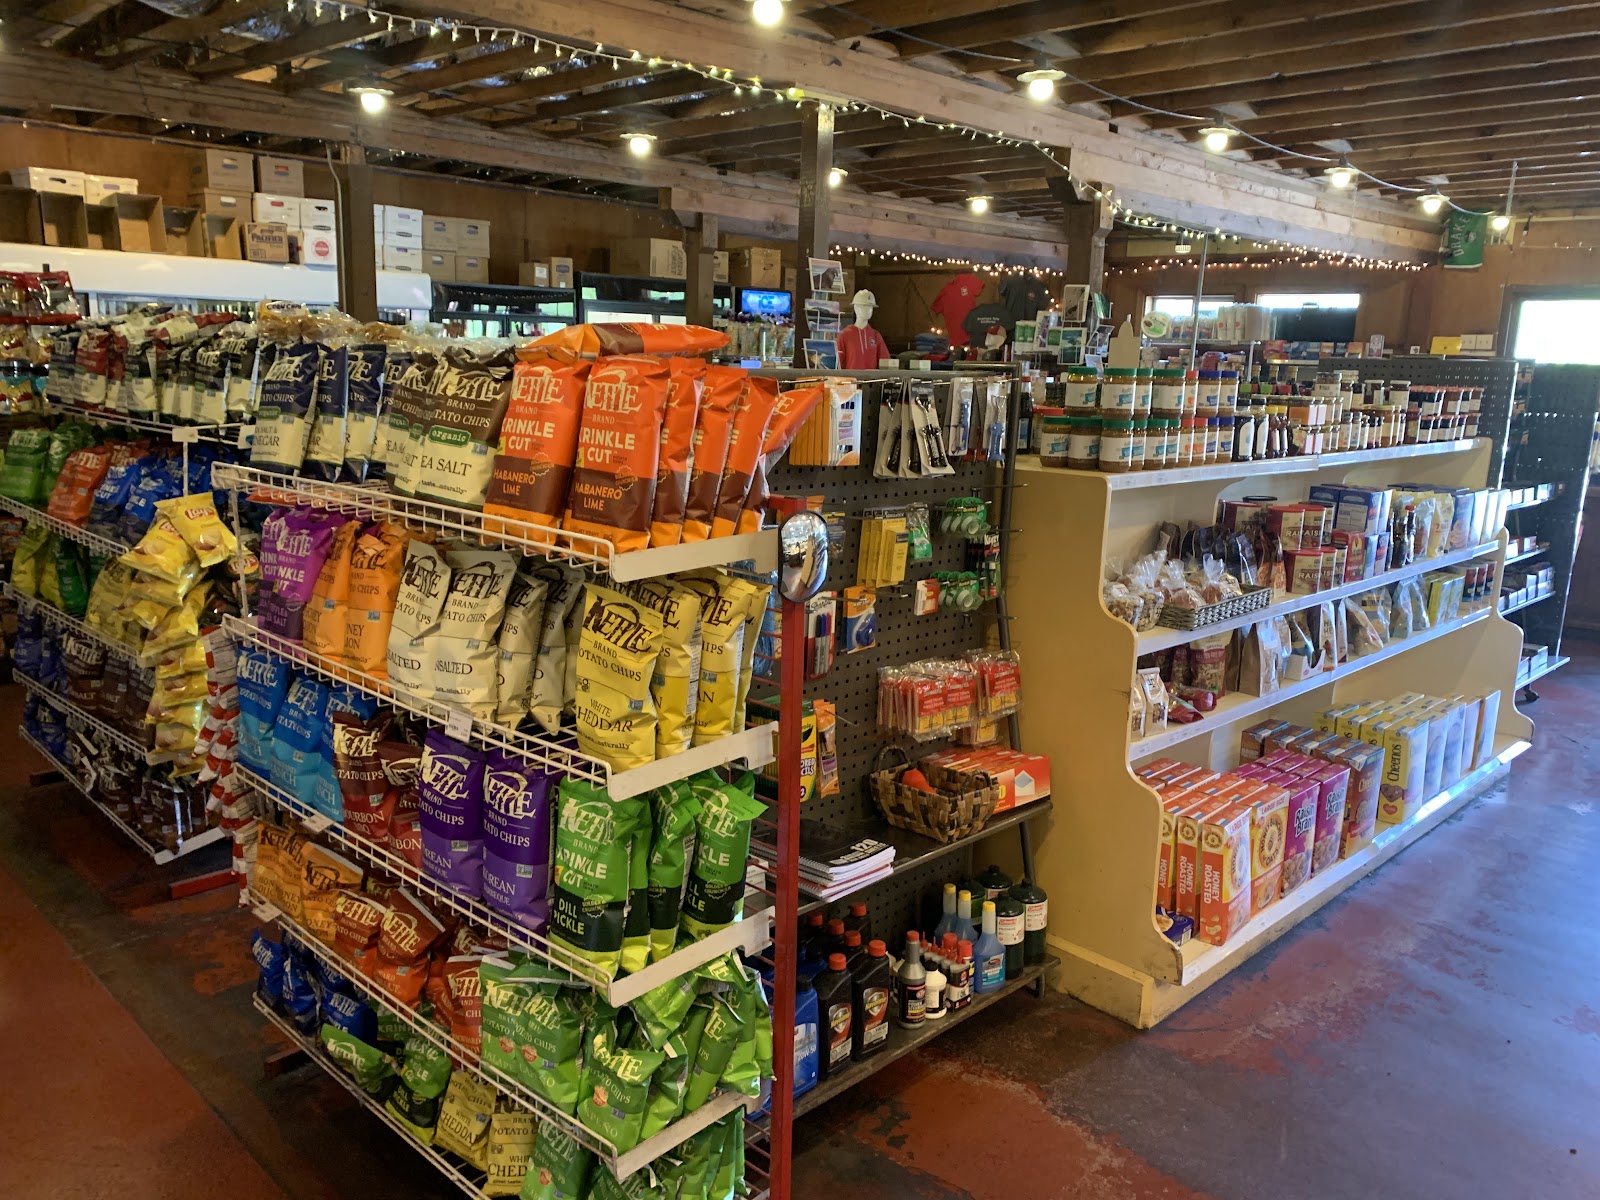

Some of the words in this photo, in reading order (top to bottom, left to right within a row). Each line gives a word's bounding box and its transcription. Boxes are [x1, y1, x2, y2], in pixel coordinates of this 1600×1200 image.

[1451, 215, 1471, 257] DRAKE
[446, 398, 476, 412] BRAND
[515, 405, 538, 416] BRAND
[434, 408, 462, 424] TATO
[462, 415, 492, 429] CHIPS
[591, 414, 615, 426] BRAND
[254, 436, 280, 447] NEGAR
[431, 430, 467, 443] organic
[508, 436, 532, 452] CUT
[586, 446, 613, 465] CUT
[420, 454, 434, 470] EA
[435, 458, 472, 477] SALT
[493, 468, 537, 486] HABANERO
[502, 484, 521, 497] LIME
[574, 481, 623, 501] HABANERO
[583, 497, 605, 512] LIME
[260, 551, 277, 565] RINK
[277, 565, 306, 583] NKLE
[401, 553, 441, 600] KETTLE
[1298, 572, 1319, 580] RAIS
[357, 585, 380, 596] CHIPS
[395, 601, 415, 617] TATO
[451, 598, 479, 610] BRAND
[443, 609, 466, 623] TATO
[466, 613, 487, 624] CHIPS
[582, 595, 653, 655] KETTLE
[346, 623, 365, 637] NEY
[504, 624, 519, 636] IPS
[592, 640, 618, 660] BRAND
[236, 650, 280, 688] KETTLE
[387, 653, 422, 671] SALTED
[434, 660, 474, 676] NSALTED
[610, 662, 643, 683] CHIPS
[590, 698, 613, 719] WHITE
[577, 704, 634, 734] HEDDAR
[1387, 743, 1402, 782] Cheerios
[338, 768, 359, 781] TATO
[419, 744, 470, 801] KETTLE
[422, 788, 442, 807] BRAND
[483, 764, 536, 820] KETTLE
[1326, 786, 1345, 808] Raisin
[418, 798, 434, 816] TATO
[435, 809, 465, 826] CHIPS
[1261, 802, 1273, 814] LARGE
[1273, 797, 1285, 808] SIZE
[1295, 801, 1314, 827] Raisin
[1327, 801, 1342, 820] Bran
[488, 809, 508, 827] BRAND
[559, 796, 618, 846] KETTLE
[1295, 817, 1312, 838] Bran
[484, 819, 499, 838] TATO
[499, 828, 531, 848] CHIPS
[851, 838, 878, 852] 120
[424, 849, 452, 870] REAN
[562, 868, 583, 888] CUT
[1158, 858, 1168, 889] HONEY
[1179, 855, 1187, 895] ROASTED
[1186, 862, 1194, 893] HONEY
[1203, 864, 1213, 904] ROASTED
[1212, 871, 1221, 902] HONEY
[558, 897, 578, 919] DILL
[686, 892, 706, 912] KLE
[349, 930, 369, 945] CHIPS
[380, 905, 421, 956] KETTLE
[498, 1012, 516, 1025] BRAN
[379, 1024, 409, 1033] KRIN
[533, 1036, 557, 1053] CHIPS
[483, 1048, 515, 1072] JALAPE
[610, 1084, 631, 1104] CHIPS
[455, 1107, 471, 1126] WHITE
[508, 1154, 530, 1164] WHIT
[487, 1162, 528, 1178] CHED
